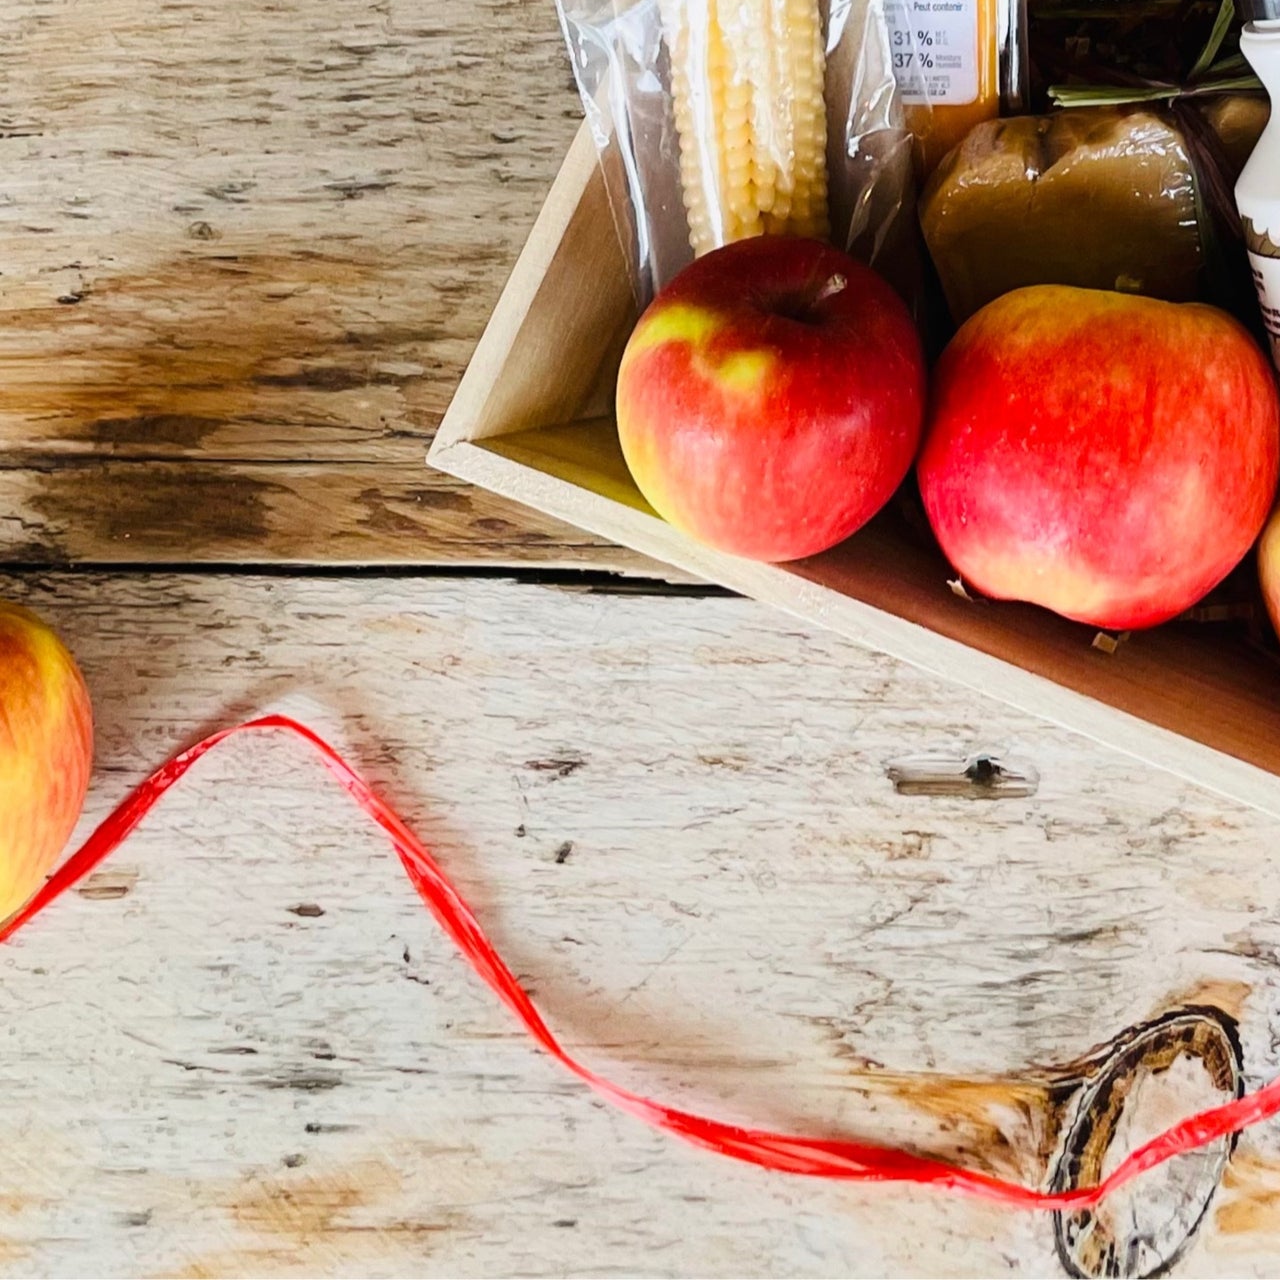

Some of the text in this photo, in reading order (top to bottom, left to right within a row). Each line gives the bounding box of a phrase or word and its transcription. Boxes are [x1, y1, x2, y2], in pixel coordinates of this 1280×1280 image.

[894, 31, 910, 46] 31
[917, 31, 933, 46] %
[895, 53, 933, 68] 37 %
